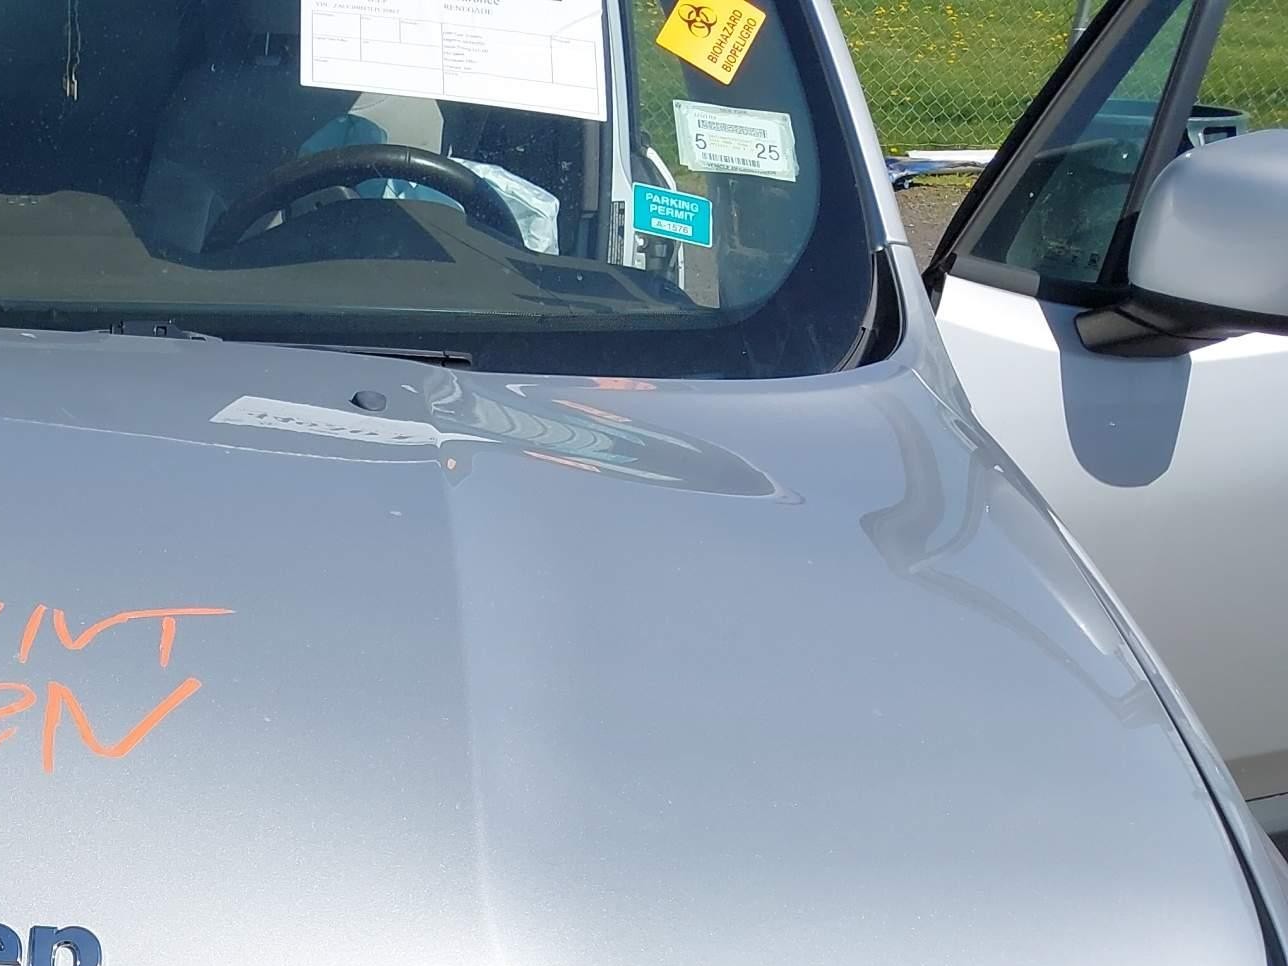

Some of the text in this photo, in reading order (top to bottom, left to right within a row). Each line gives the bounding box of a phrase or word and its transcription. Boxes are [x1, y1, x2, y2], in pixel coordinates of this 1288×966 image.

[707, 9, 743, 63] BIOHAZARD
[721, 18, 757, 72] BIOPELIGRO
[695, 133, 707, 150] 5
[755, 142, 780, 161] 25
[645, 192, 699, 213] PARKING
[649, 203, 696, 222] PERMIT
